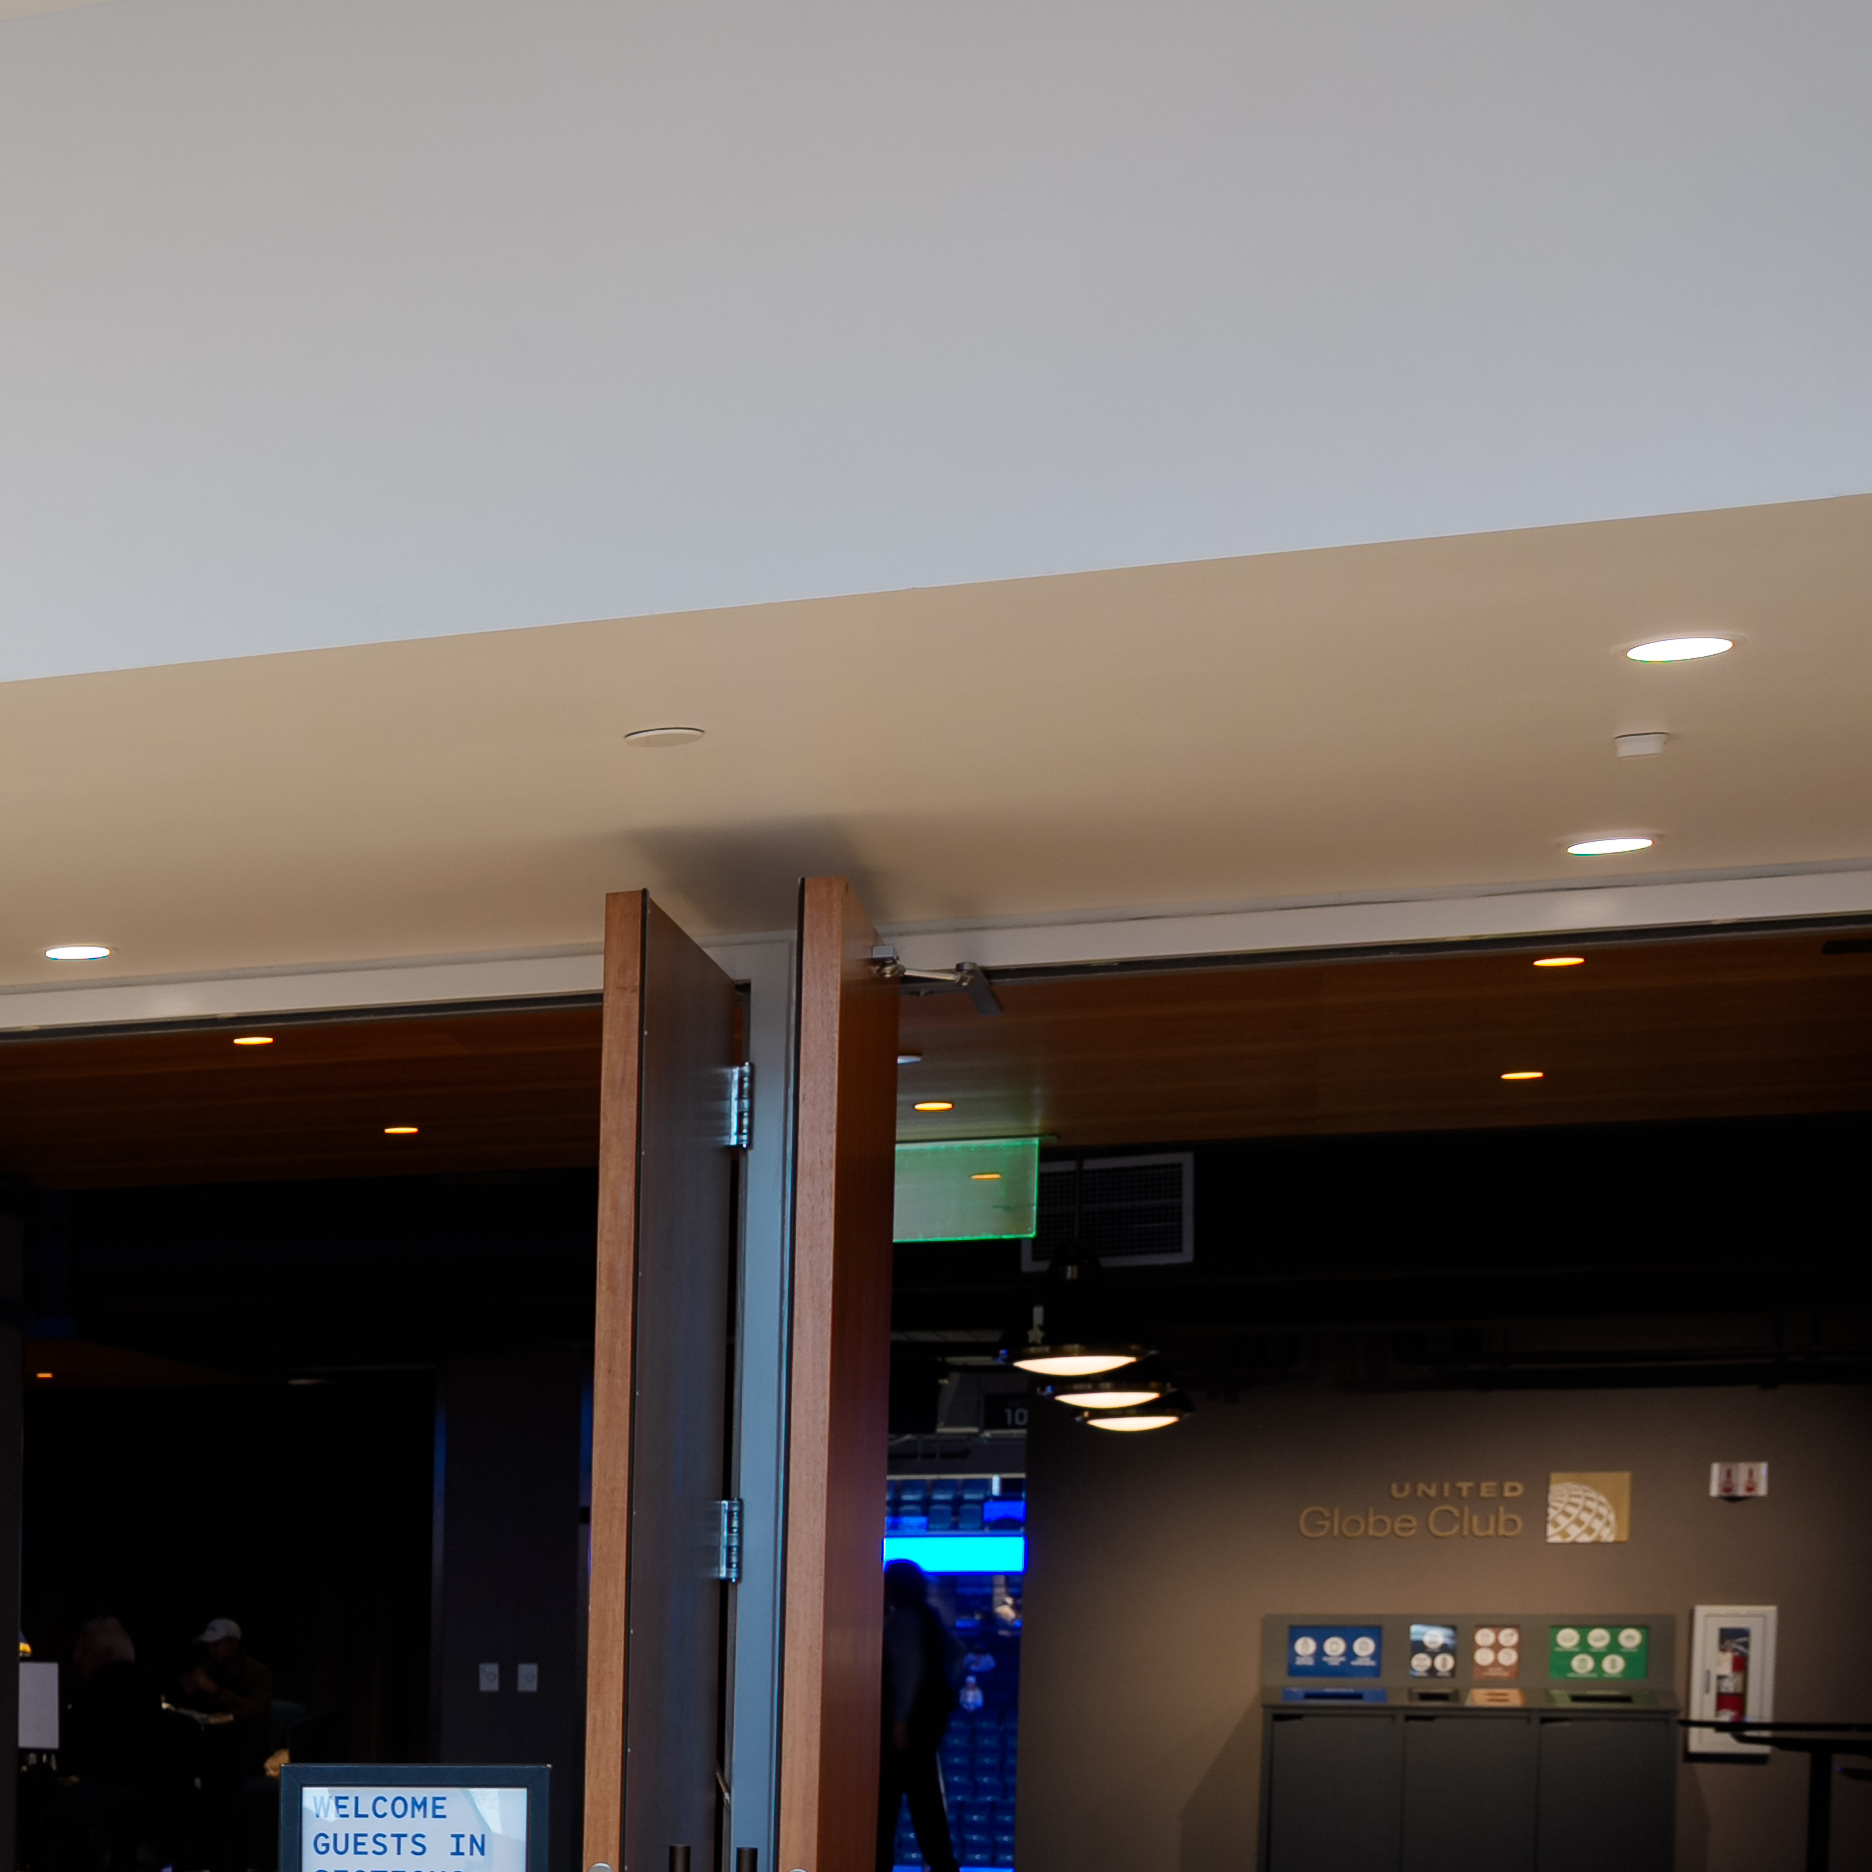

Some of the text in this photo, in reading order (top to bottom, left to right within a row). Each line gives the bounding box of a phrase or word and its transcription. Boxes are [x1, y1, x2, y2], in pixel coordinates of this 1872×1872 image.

[1390, 1481, 1525, 1498] UNITED
[1299, 1504, 1524, 1538] Globe Club
[313, 1795, 448, 1819] WELCOME
[312, 1832, 487, 1857] GUESTS IN
